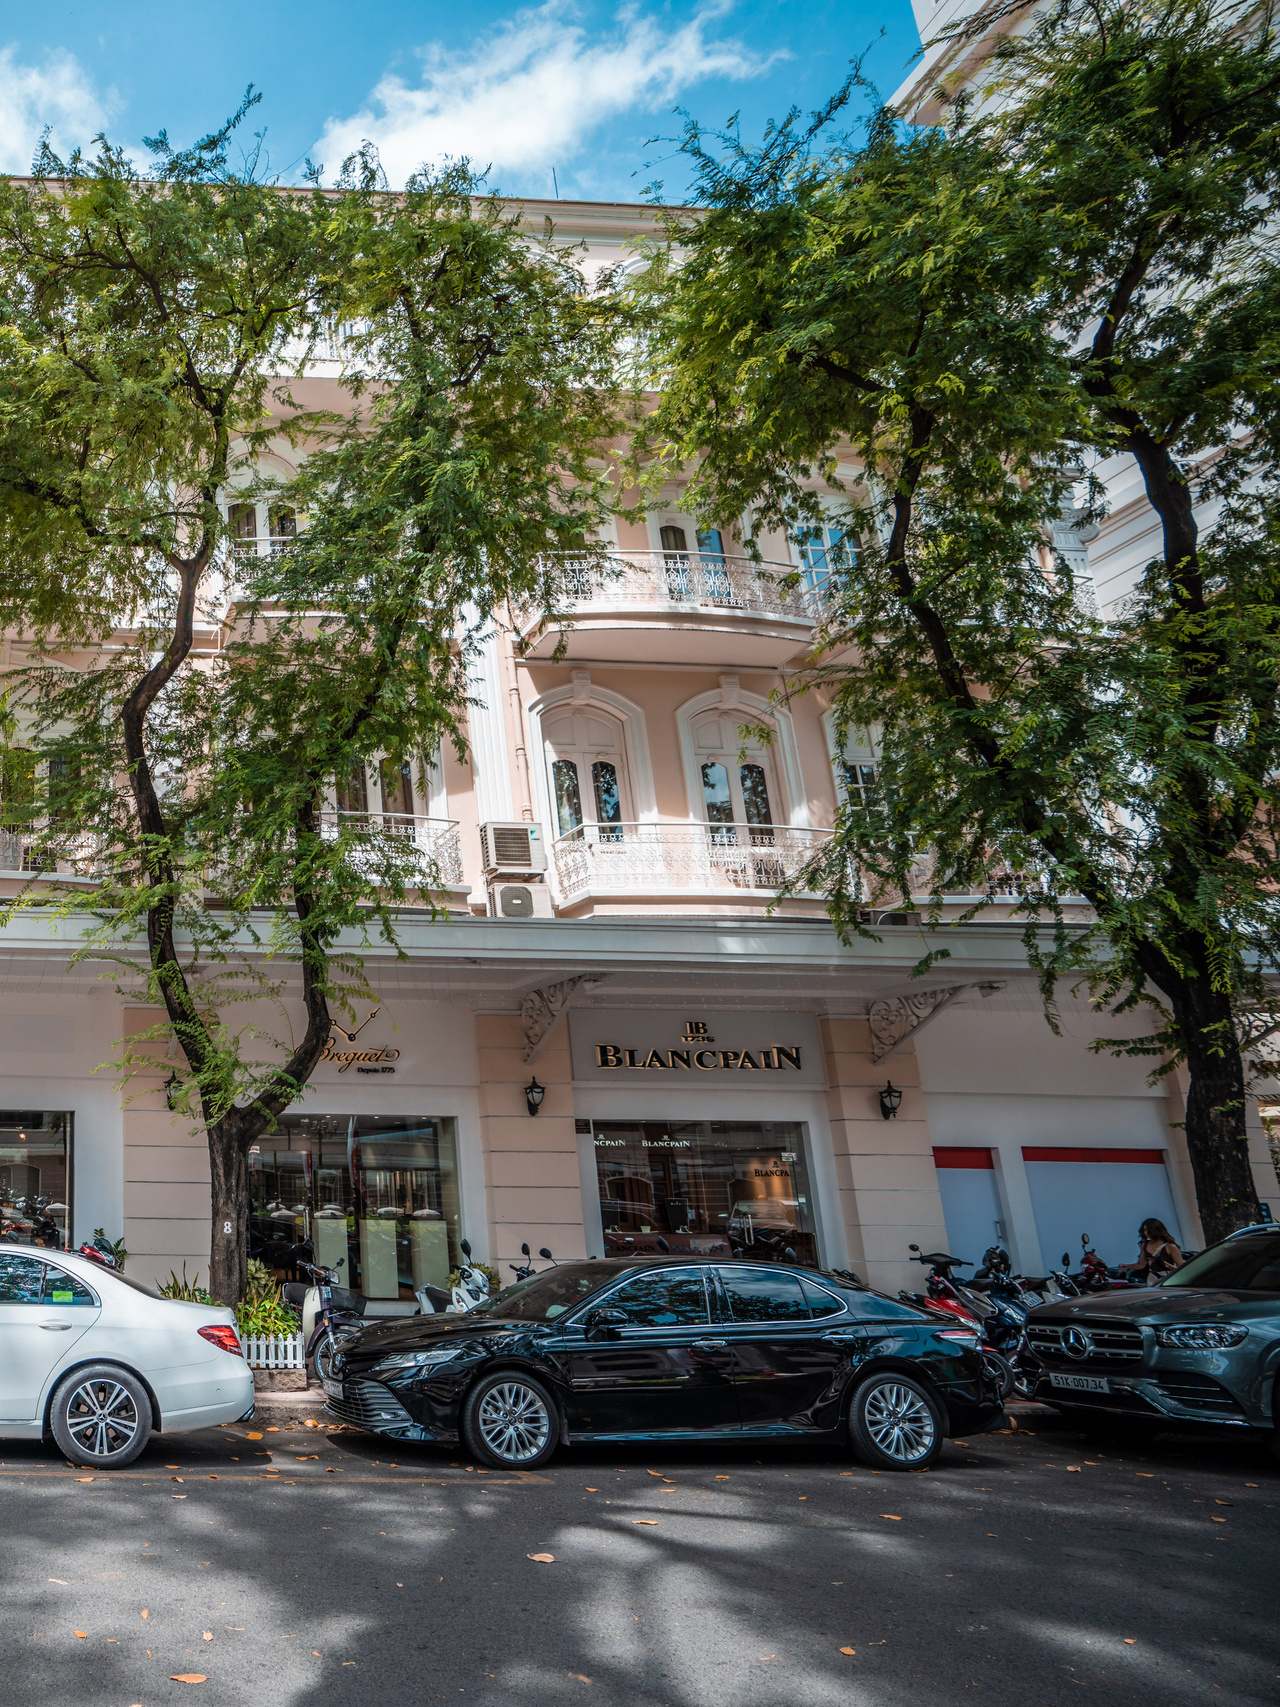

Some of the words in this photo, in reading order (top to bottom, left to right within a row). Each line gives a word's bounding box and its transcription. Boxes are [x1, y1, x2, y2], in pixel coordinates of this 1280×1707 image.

[320, 1036, 400, 1073] Breguet
[596, 1044, 802, 1071] BLANCPAIN
[641, 1139, 691, 1148] BLANCPAIN
[223, 1221, 233, 1234] 8
[1054, 1375, 1104, 1391] 51K-007.34
